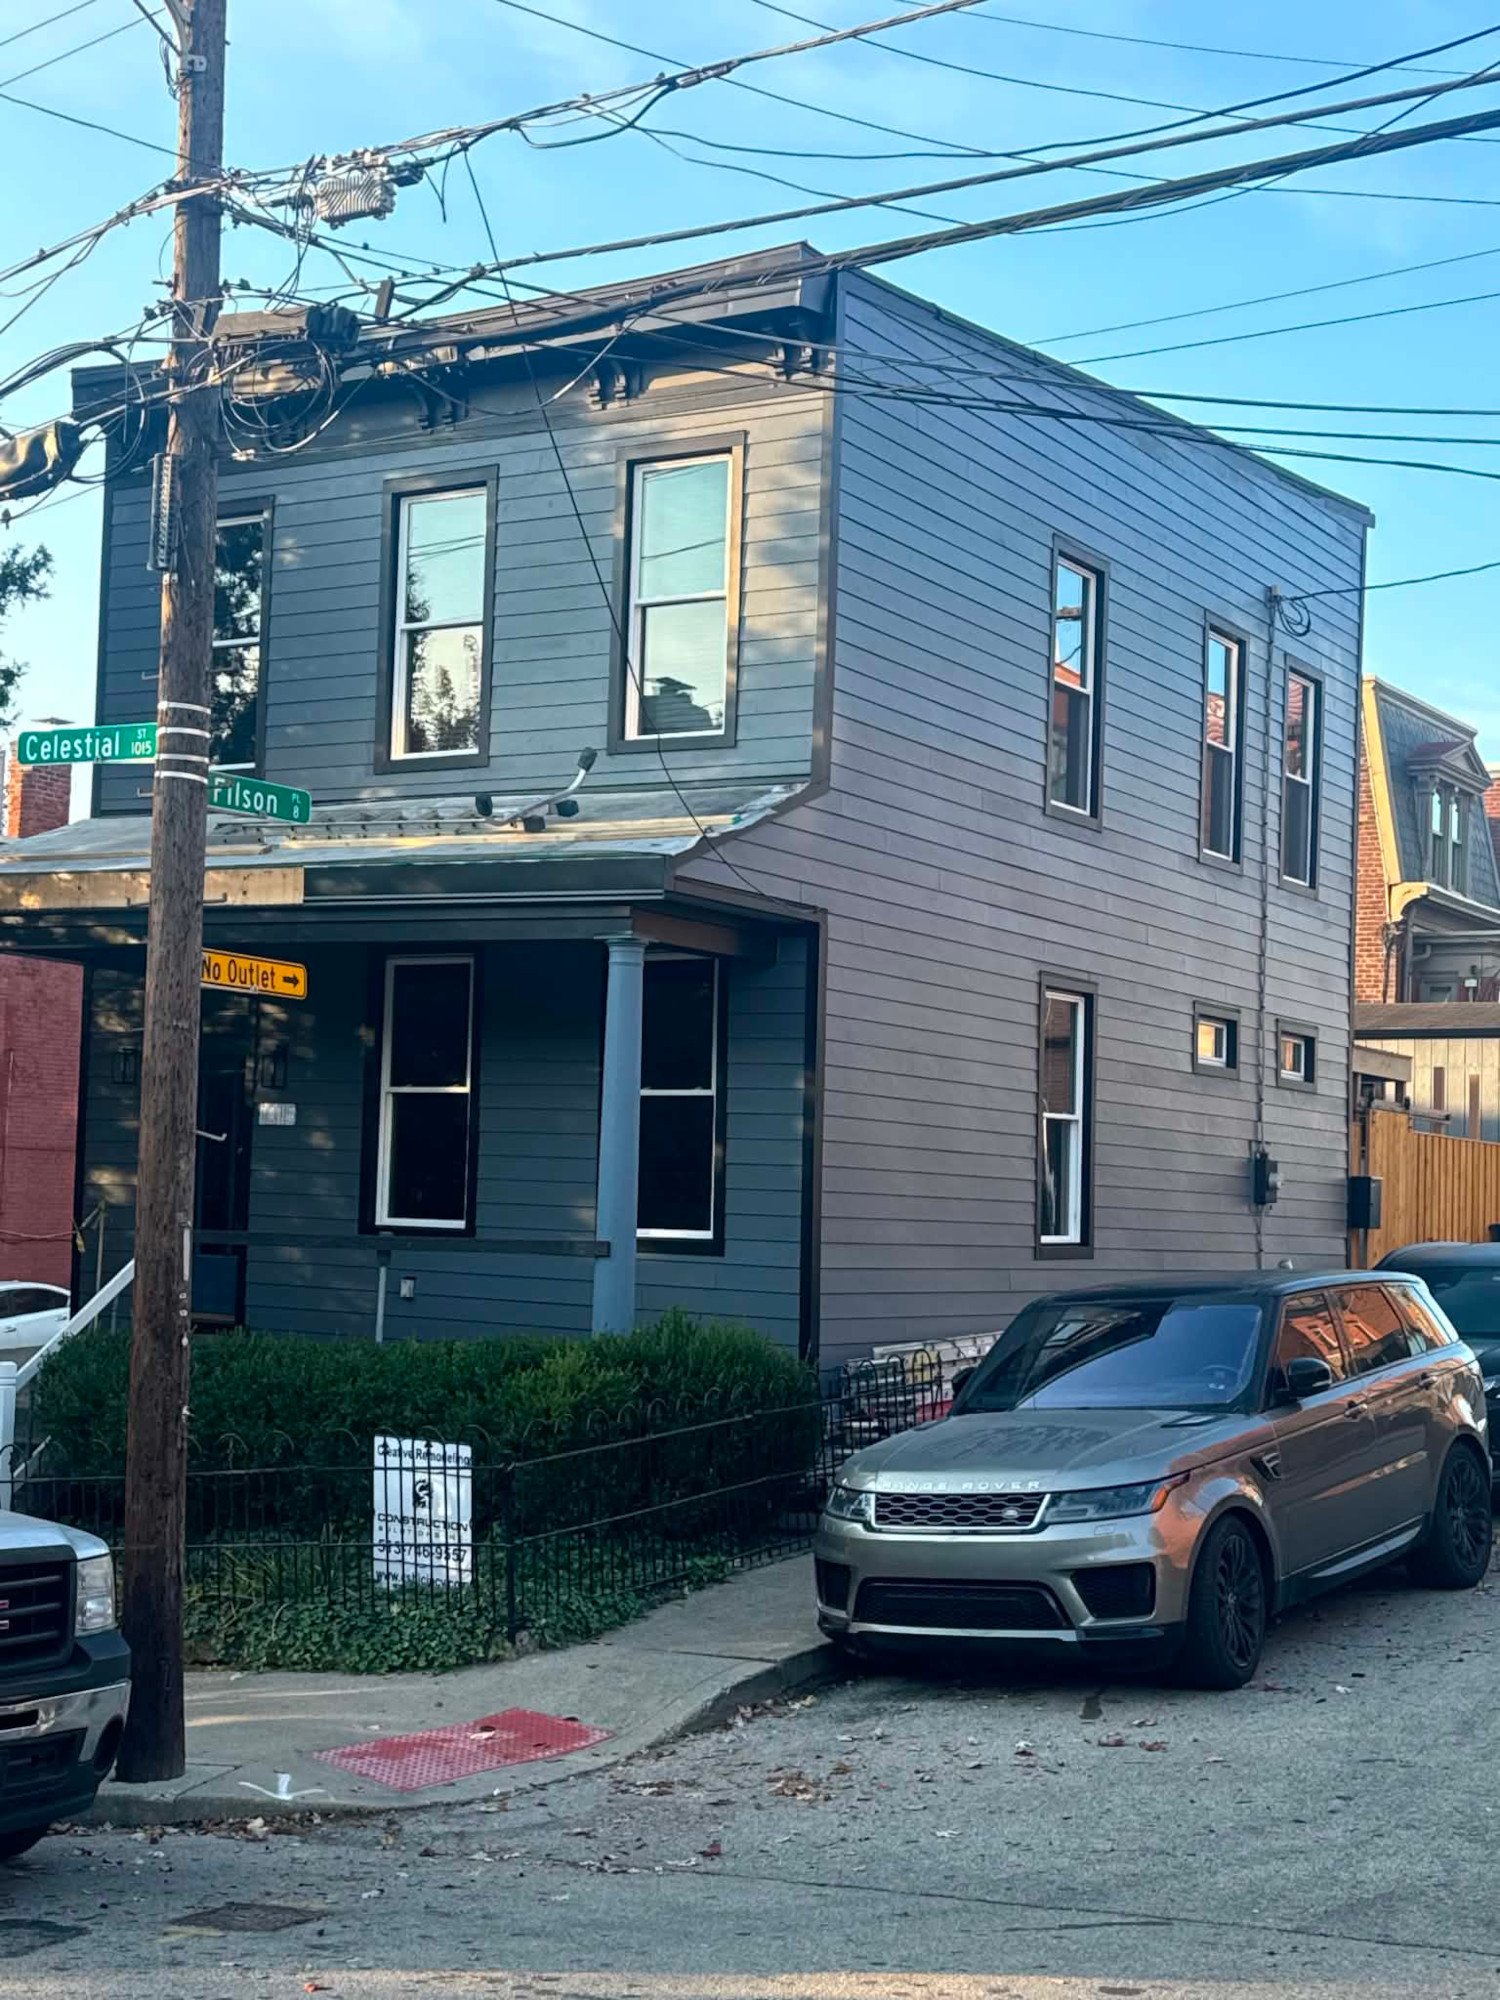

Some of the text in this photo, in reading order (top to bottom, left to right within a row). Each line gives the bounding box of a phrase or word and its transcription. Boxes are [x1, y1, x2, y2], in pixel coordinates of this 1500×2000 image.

[26, 728, 147, 760] Celestial ST
[131, 740, 153, 756] 1015
[213, 777, 301, 814] Filson PL
[292, 804, 300, 819] 8
[201, 955, 276, 989] No Outlet
[377, 1444, 471, 1466] Ceave Remoelng
[961, 1480, 1041, 1491] ROVER
